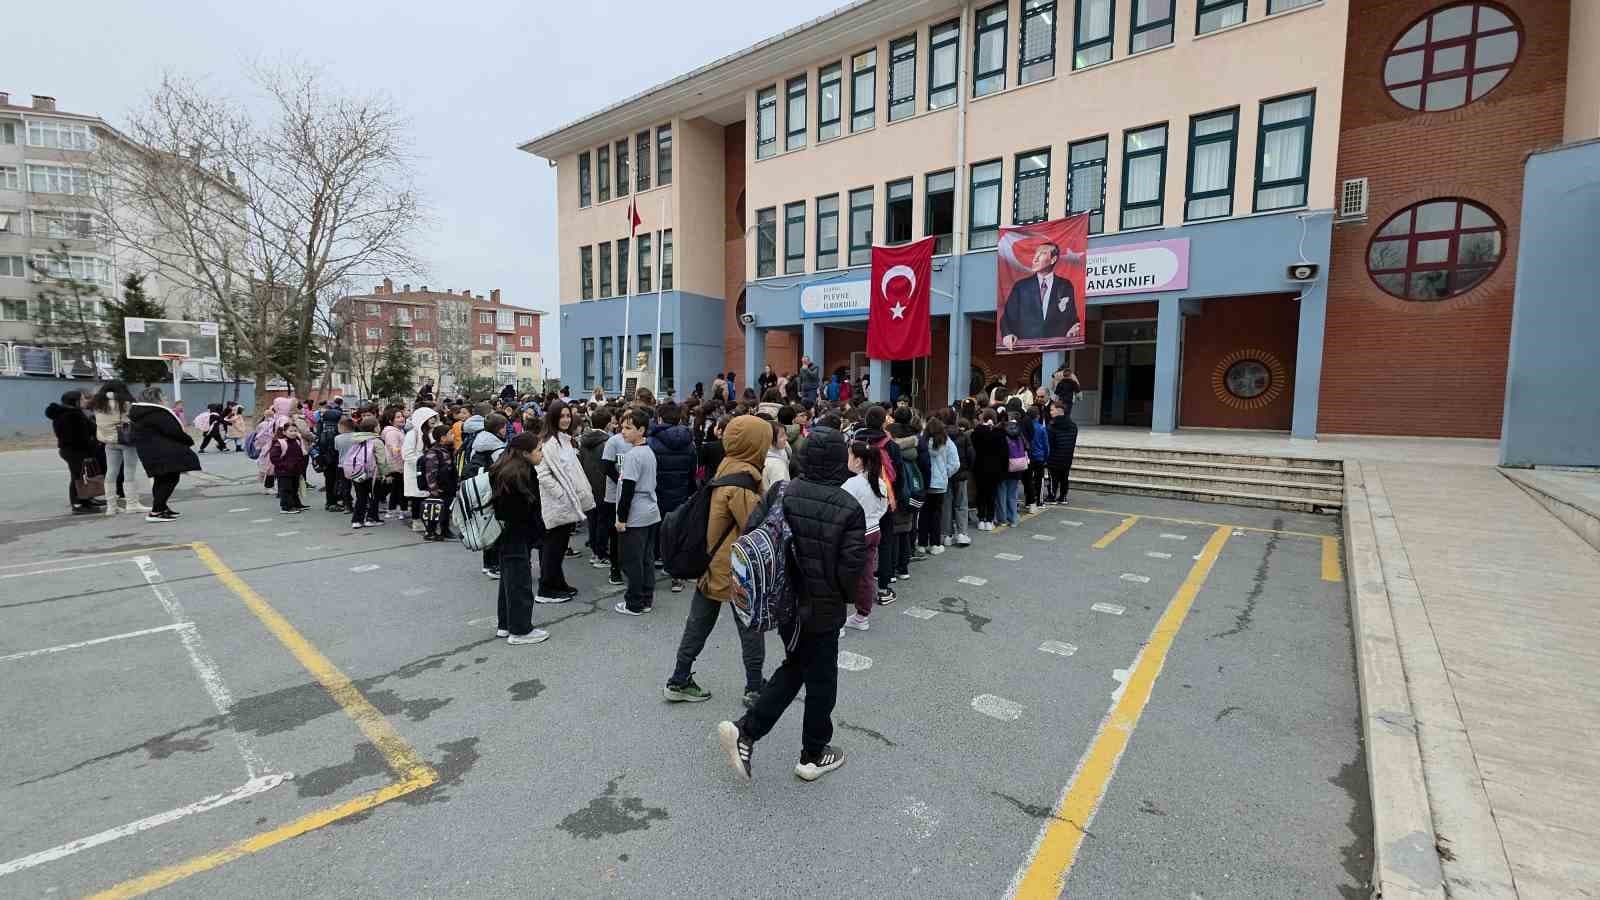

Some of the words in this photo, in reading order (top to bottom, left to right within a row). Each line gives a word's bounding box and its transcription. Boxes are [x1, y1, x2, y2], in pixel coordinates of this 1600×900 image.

[1087, 263, 1136, 276] PLEVNE
[1087, 275, 1155, 290] ANASINIFI
[823, 292, 849, 301] PLEVNE
